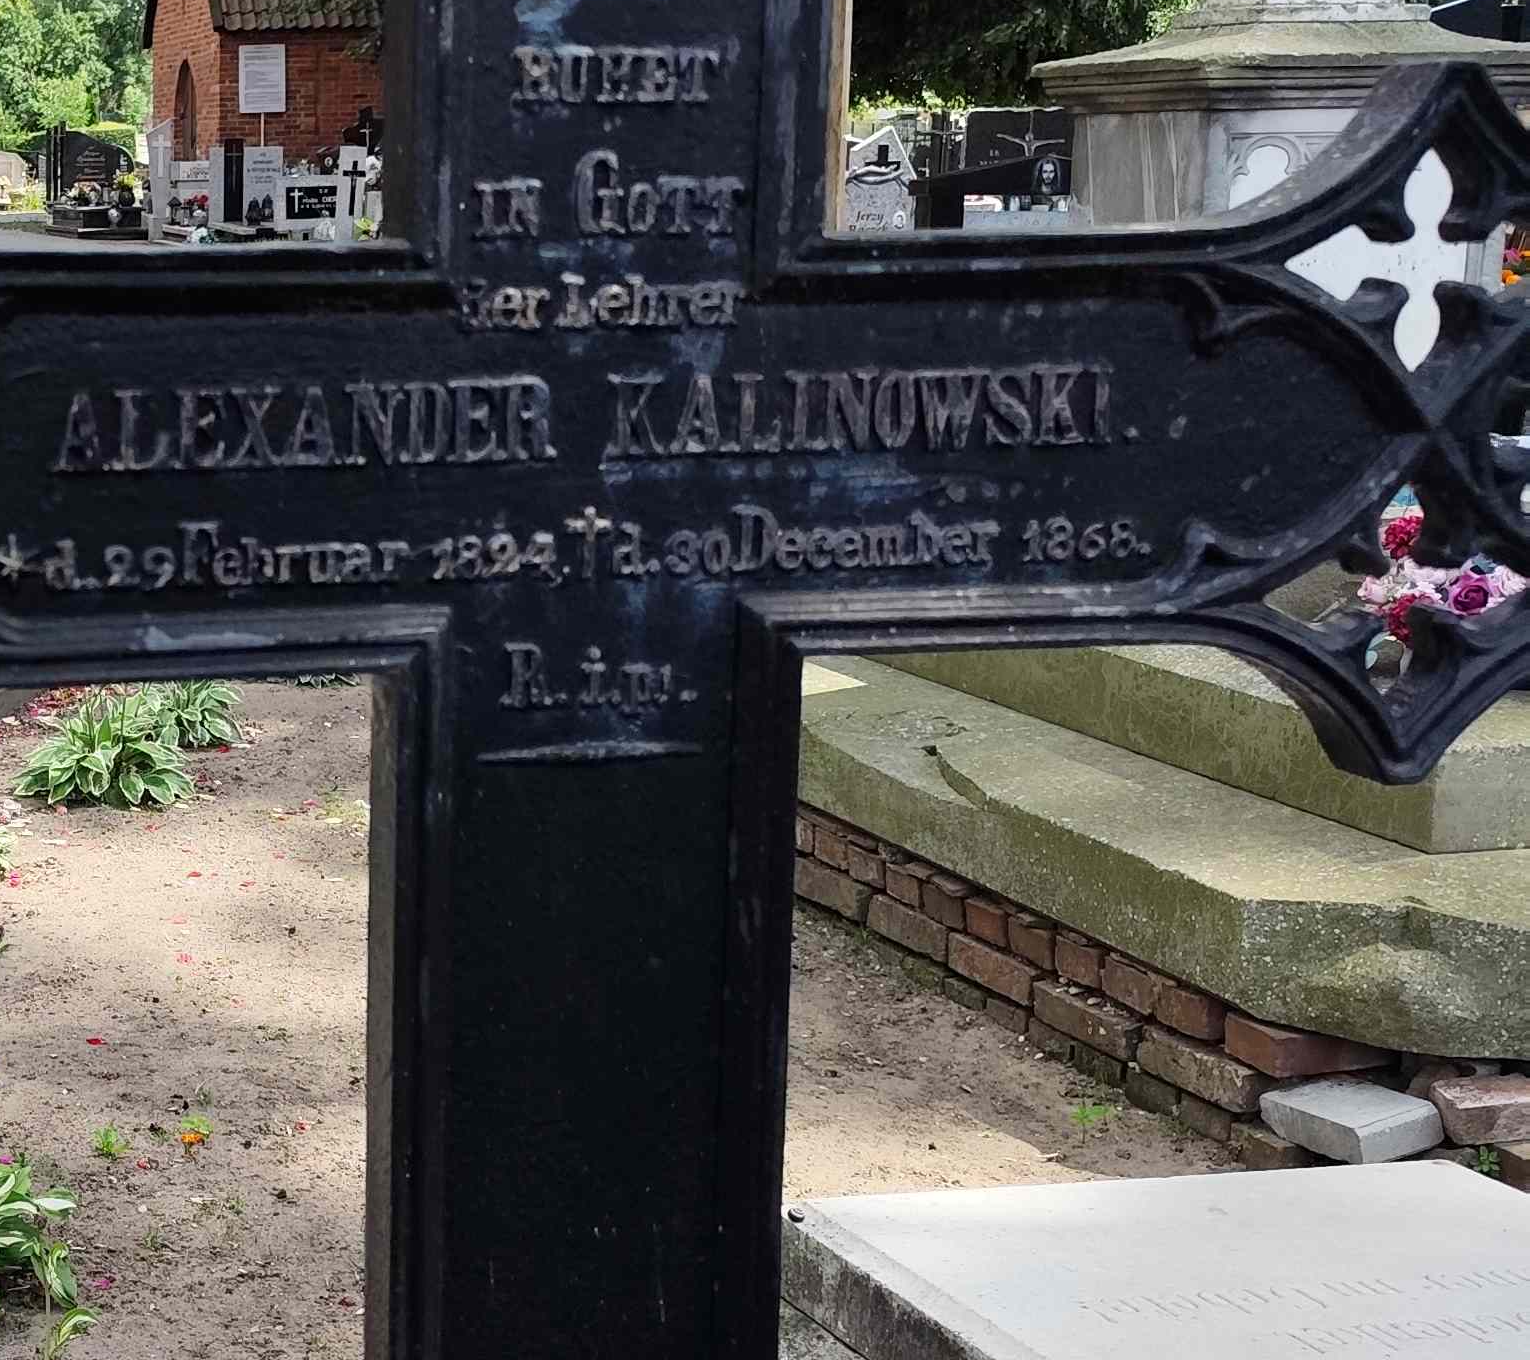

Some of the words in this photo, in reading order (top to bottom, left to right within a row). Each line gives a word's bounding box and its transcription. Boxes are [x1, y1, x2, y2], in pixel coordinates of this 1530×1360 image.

[554, 270, 746, 329] Lehrer
[50, 374, 558, 472] ALEXANDER
[600, 362, 1139, 458] KALINOWSKI.
[728, 502, 1002, 572] December
